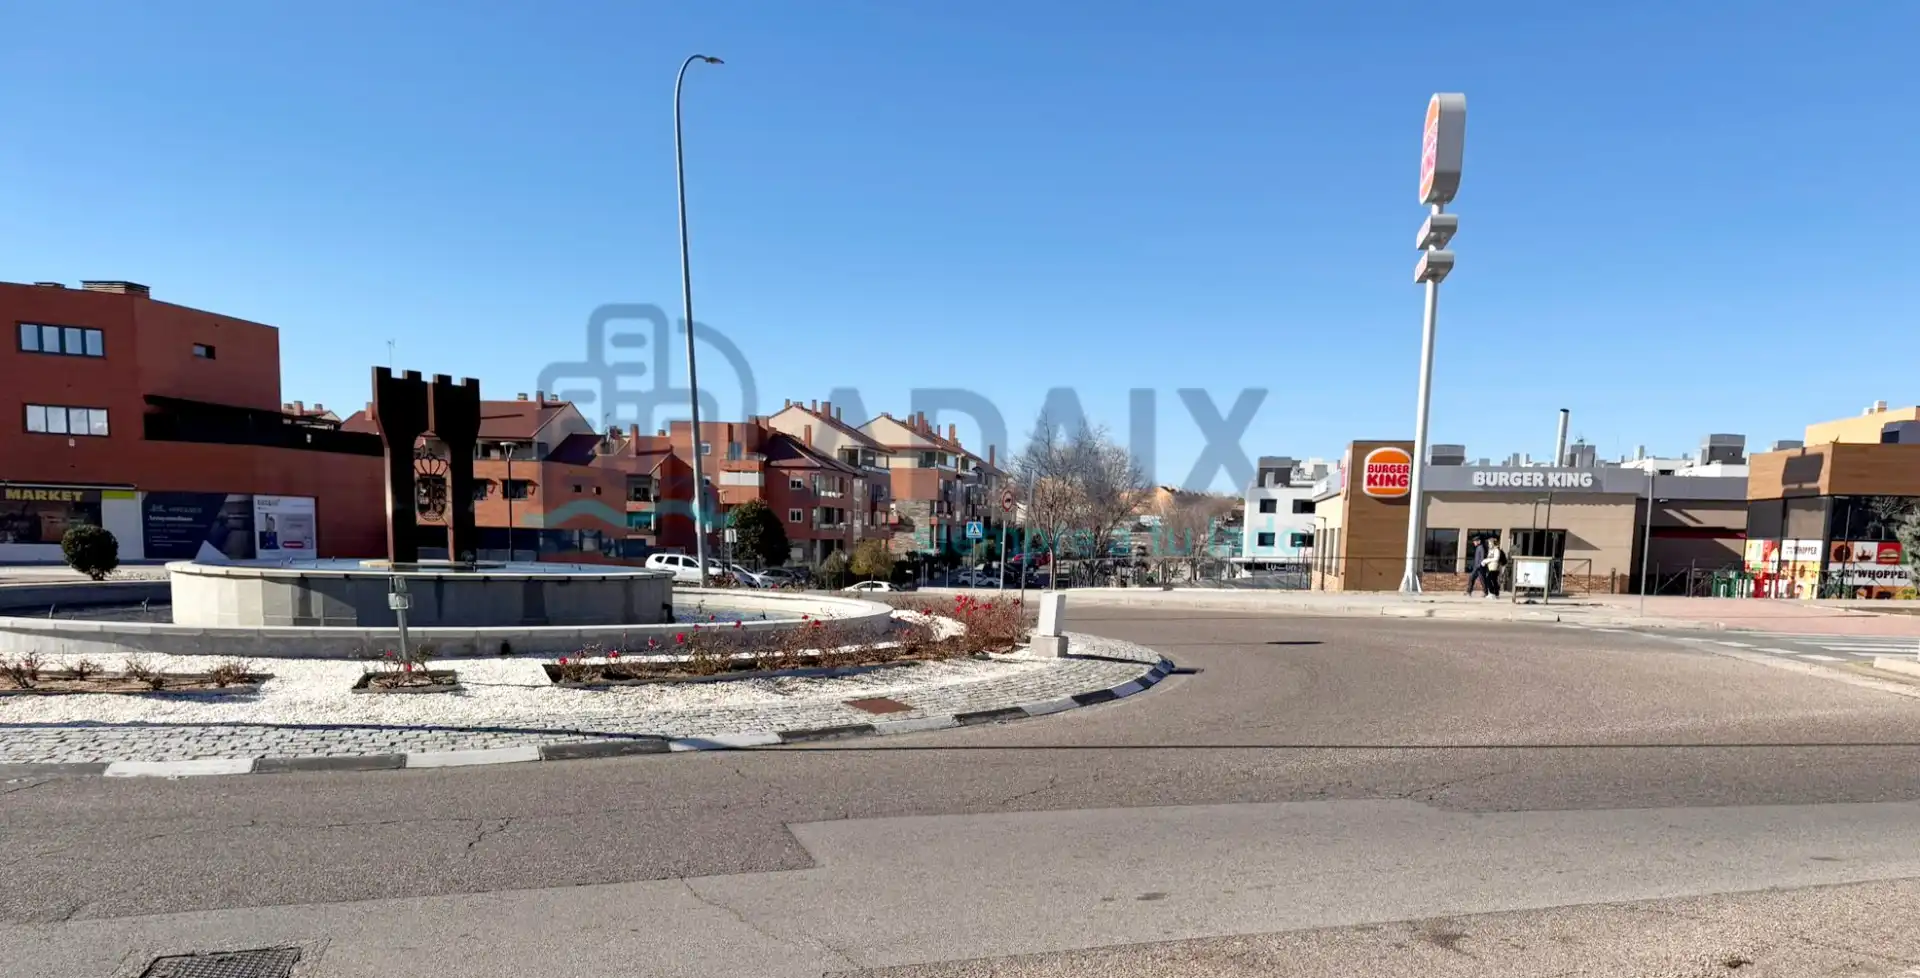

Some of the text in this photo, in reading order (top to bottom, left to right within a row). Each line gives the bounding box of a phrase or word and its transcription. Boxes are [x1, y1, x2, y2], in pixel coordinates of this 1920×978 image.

[1368, 464, 1409, 473] BURGER
[1367, 474, 1409, 487] KING
[1472, 471, 1593, 488] BURGER KING
[5, 488, 83, 502] MARKET
